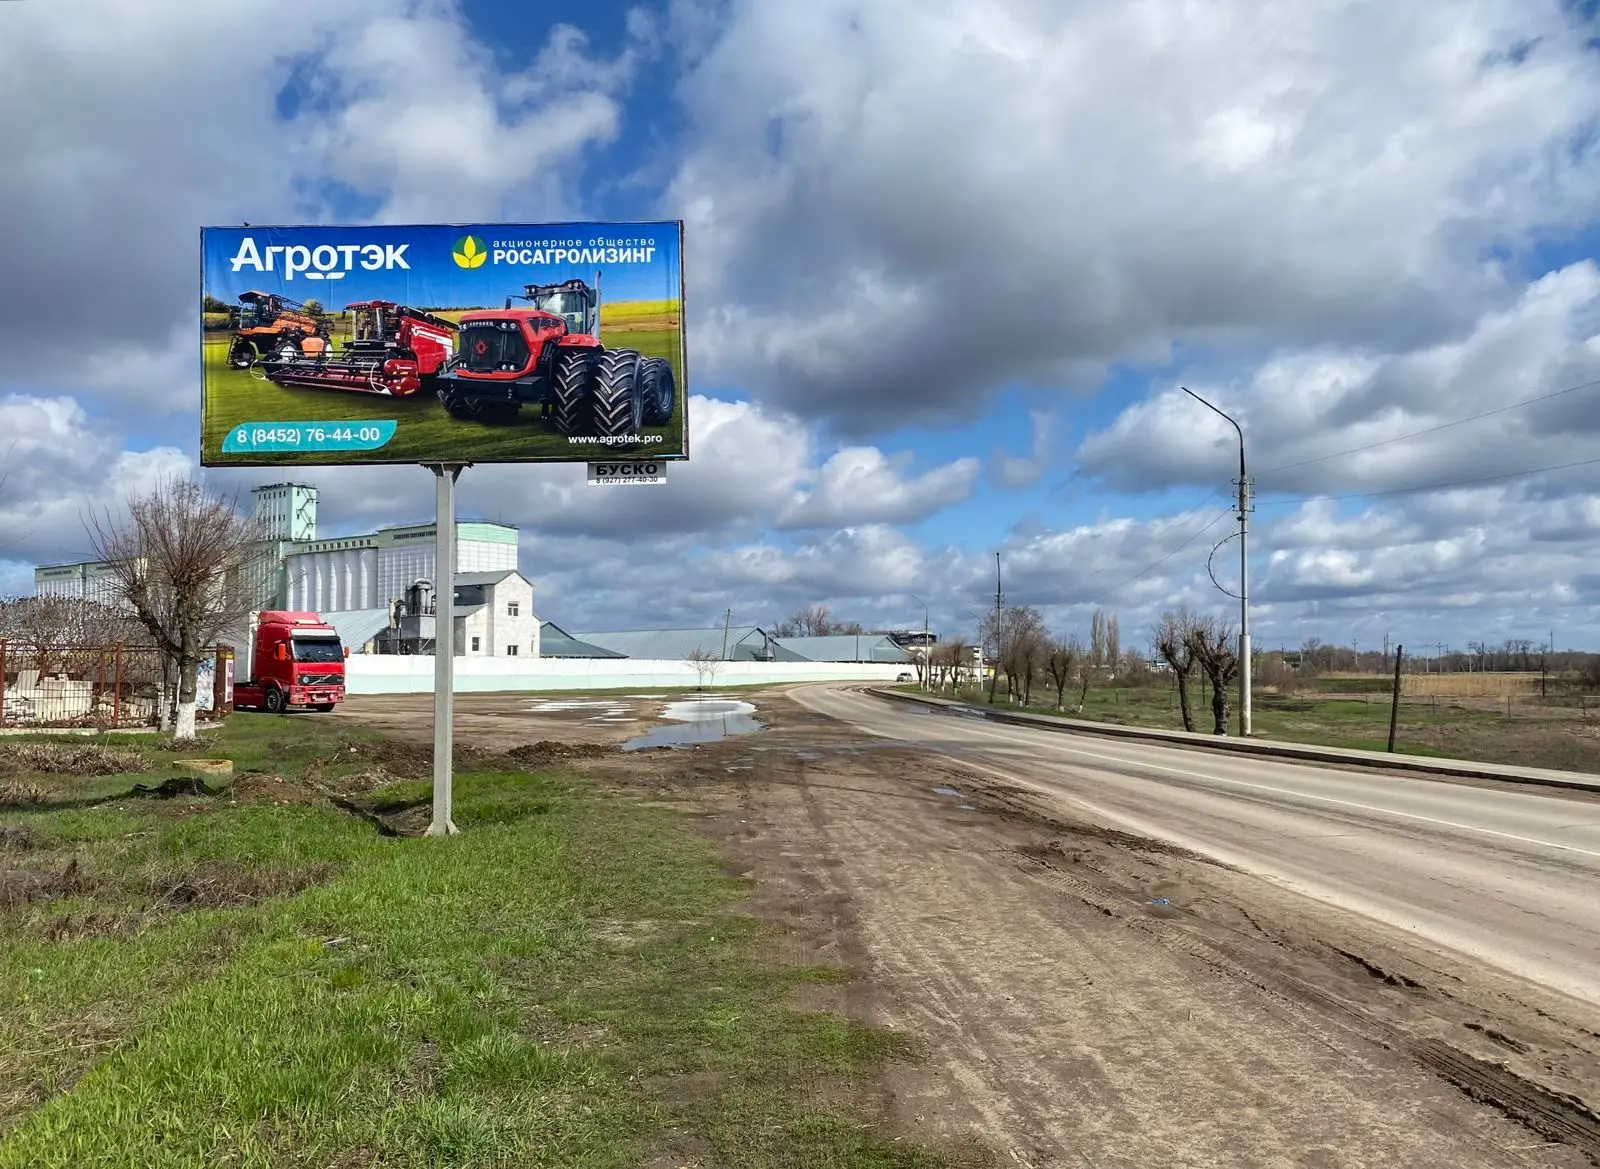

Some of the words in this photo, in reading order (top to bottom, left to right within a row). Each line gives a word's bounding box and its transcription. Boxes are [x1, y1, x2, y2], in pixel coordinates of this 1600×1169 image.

[493, 238, 582, 249] акционерное
[589, 236, 655, 247] общество
[493, 247, 655, 265] РОСАГРОЛИЗИНГ
[236, 430, 247, 443] 8
[252, 429, 301, 446] (8452)
[306, 427, 380, 442] 76-44-00
[568, 434, 662, 445] www.agrotek.pro
[596, 464, 658, 475] БУСКО
[602, 476, 621, 485] (927)
